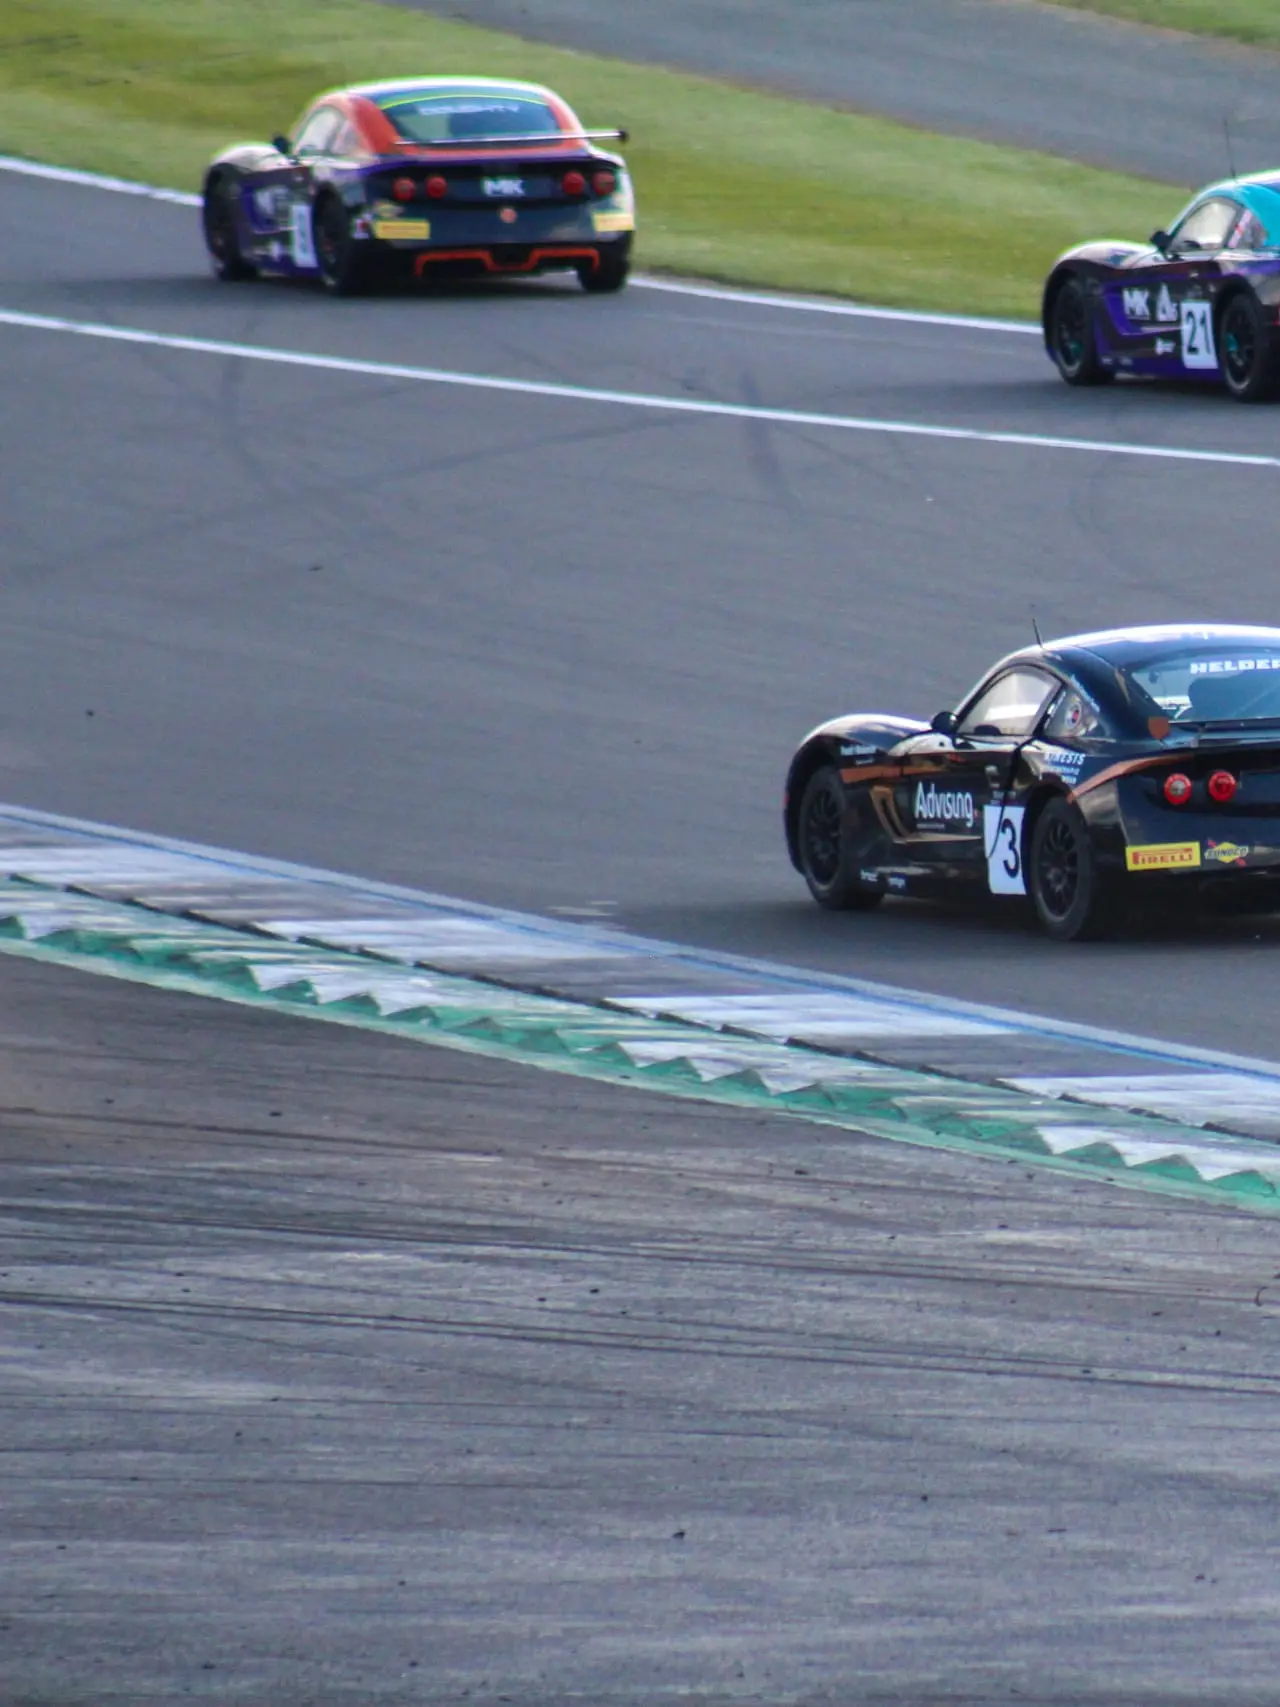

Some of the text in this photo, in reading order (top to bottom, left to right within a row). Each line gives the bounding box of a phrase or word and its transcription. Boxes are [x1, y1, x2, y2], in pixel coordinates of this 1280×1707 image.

[1122, 289, 1150, 317] MK
[1186, 309, 1211, 355] 21
[1132, 848, 1193, 865] PIRELLI
